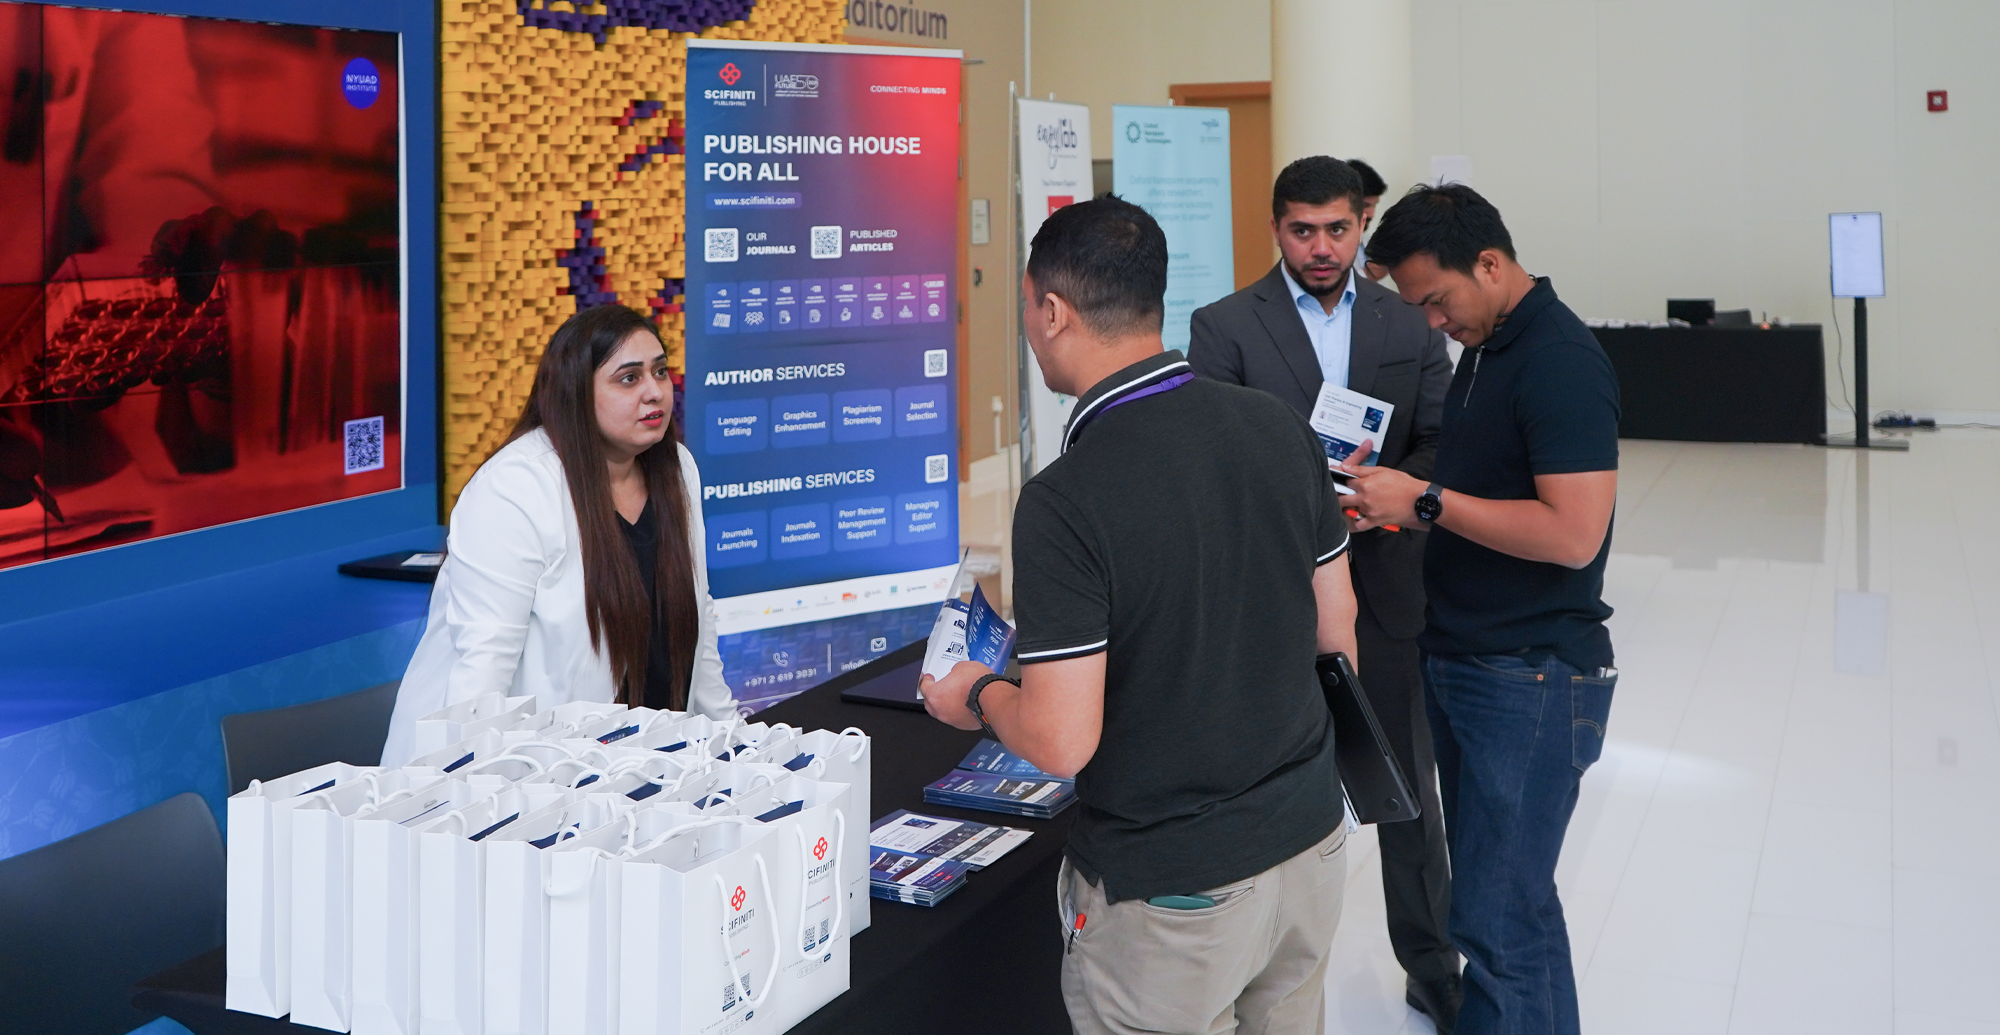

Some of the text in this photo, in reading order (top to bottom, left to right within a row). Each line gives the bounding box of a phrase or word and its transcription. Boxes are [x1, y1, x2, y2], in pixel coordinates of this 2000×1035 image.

[345, 74, 378, 84] NYUAD
[345, 84, 378, 92] INSTITUTE
[870, 85, 947, 95] CONNECTING MINDS
[704, 89, 756, 100] SCIFINITI
[703, 135, 921, 155] PUBLISHING HOUSE
[703, 162, 800, 182] FOR ALL
[714, 195, 796, 206] www.scifiniti.com
[746, 232, 767, 241] OUR
[849, 230, 898, 239] PUBLISHED
[746, 245, 796, 256] JOURNALS
[849, 242, 894, 252] ARTICLES
[704, 363, 846, 387] AUTHOR SERVICES
[843, 404, 882, 415] Plagiarism
[909, 400, 935, 410] Journal
[718, 415, 757, 427] Language
[783, 410, 818, 421] Graphics
[843, 415, 882, 426] Screening
[906, 411, 938, 422] Selection
[724, 426, 752, 437] Editing
[775, 421, 827, 433] Enhancement
[704, 469, 875, 500] PUBLISHING SERVICES
[905, 500, 940, 511] Managing
[839, 506, 885, 518] Peer Review
[912, 511, 933, 522] Editor
[785, 520, 816, 532] Journals
[838, 517, 887, 530] Management
[908, 521, 936, 533] Support
[721, 527, 754, 539] Journals
[781, 531, 821, 543] Indexation
[846, 529, 877, 540] Support
[716, 539, 758, 552] Launching
[745, 676, 767, 688] +971
[769, 675, 776, 684] 2
[777, 671, 794, 682] 619
[808, 858, 835, 880] CIFINITI
